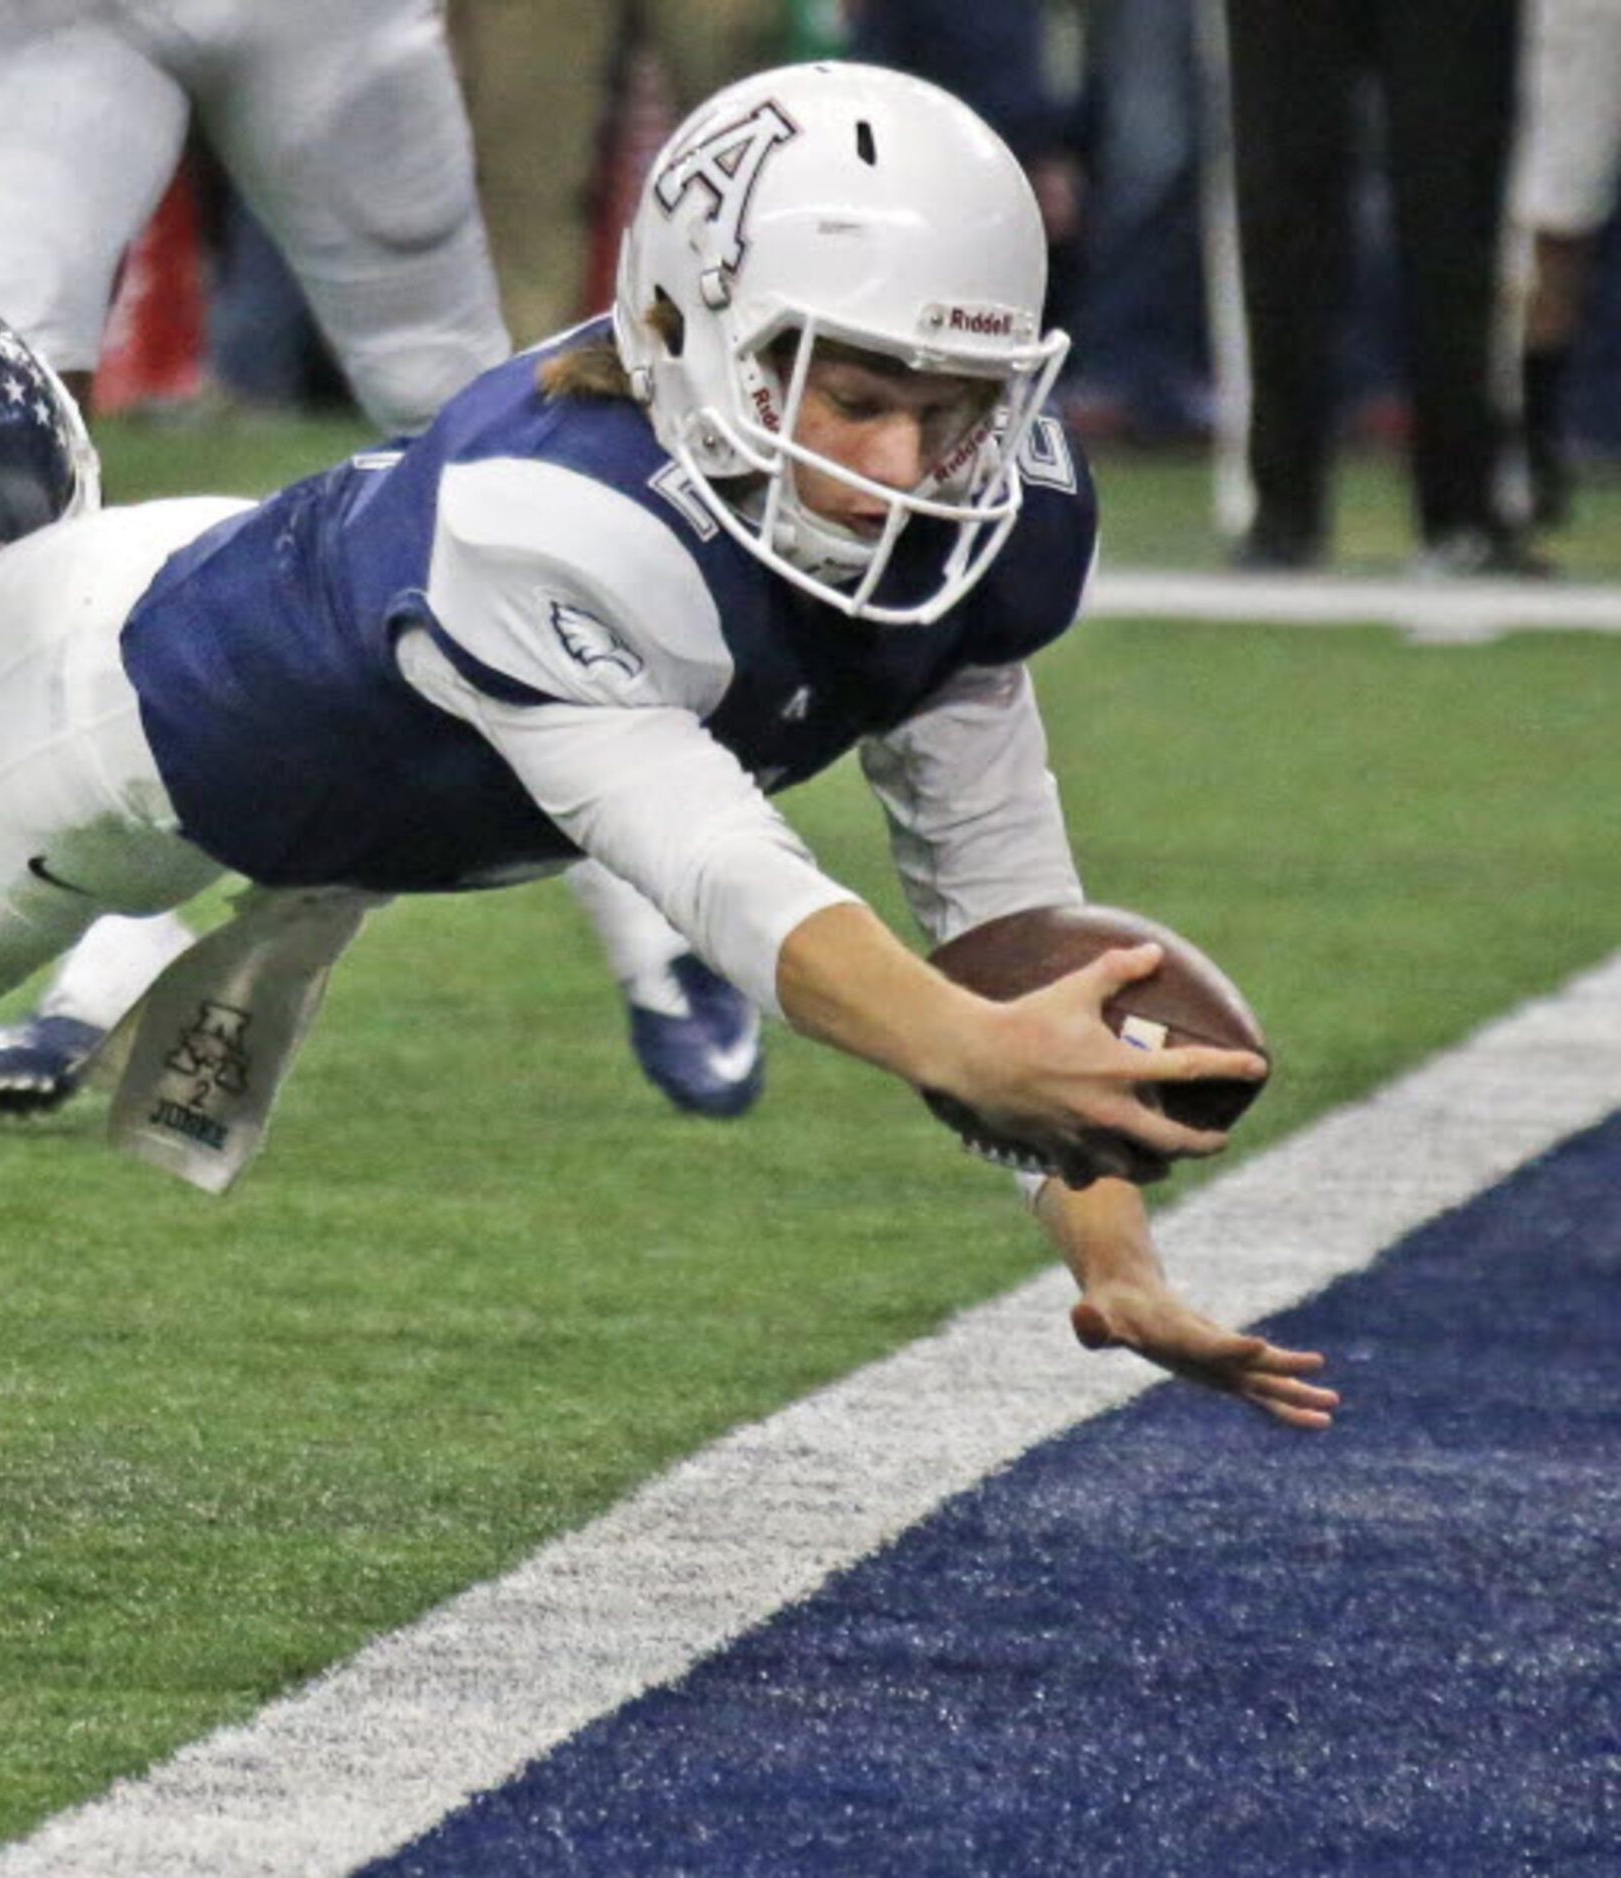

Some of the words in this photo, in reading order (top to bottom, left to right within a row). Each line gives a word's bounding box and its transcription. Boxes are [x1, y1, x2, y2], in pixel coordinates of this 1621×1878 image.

[654, 101, 798, 276] A
[948, 306, 1015, 335] Riddell
[190, 1080, 211, 1108] 2
